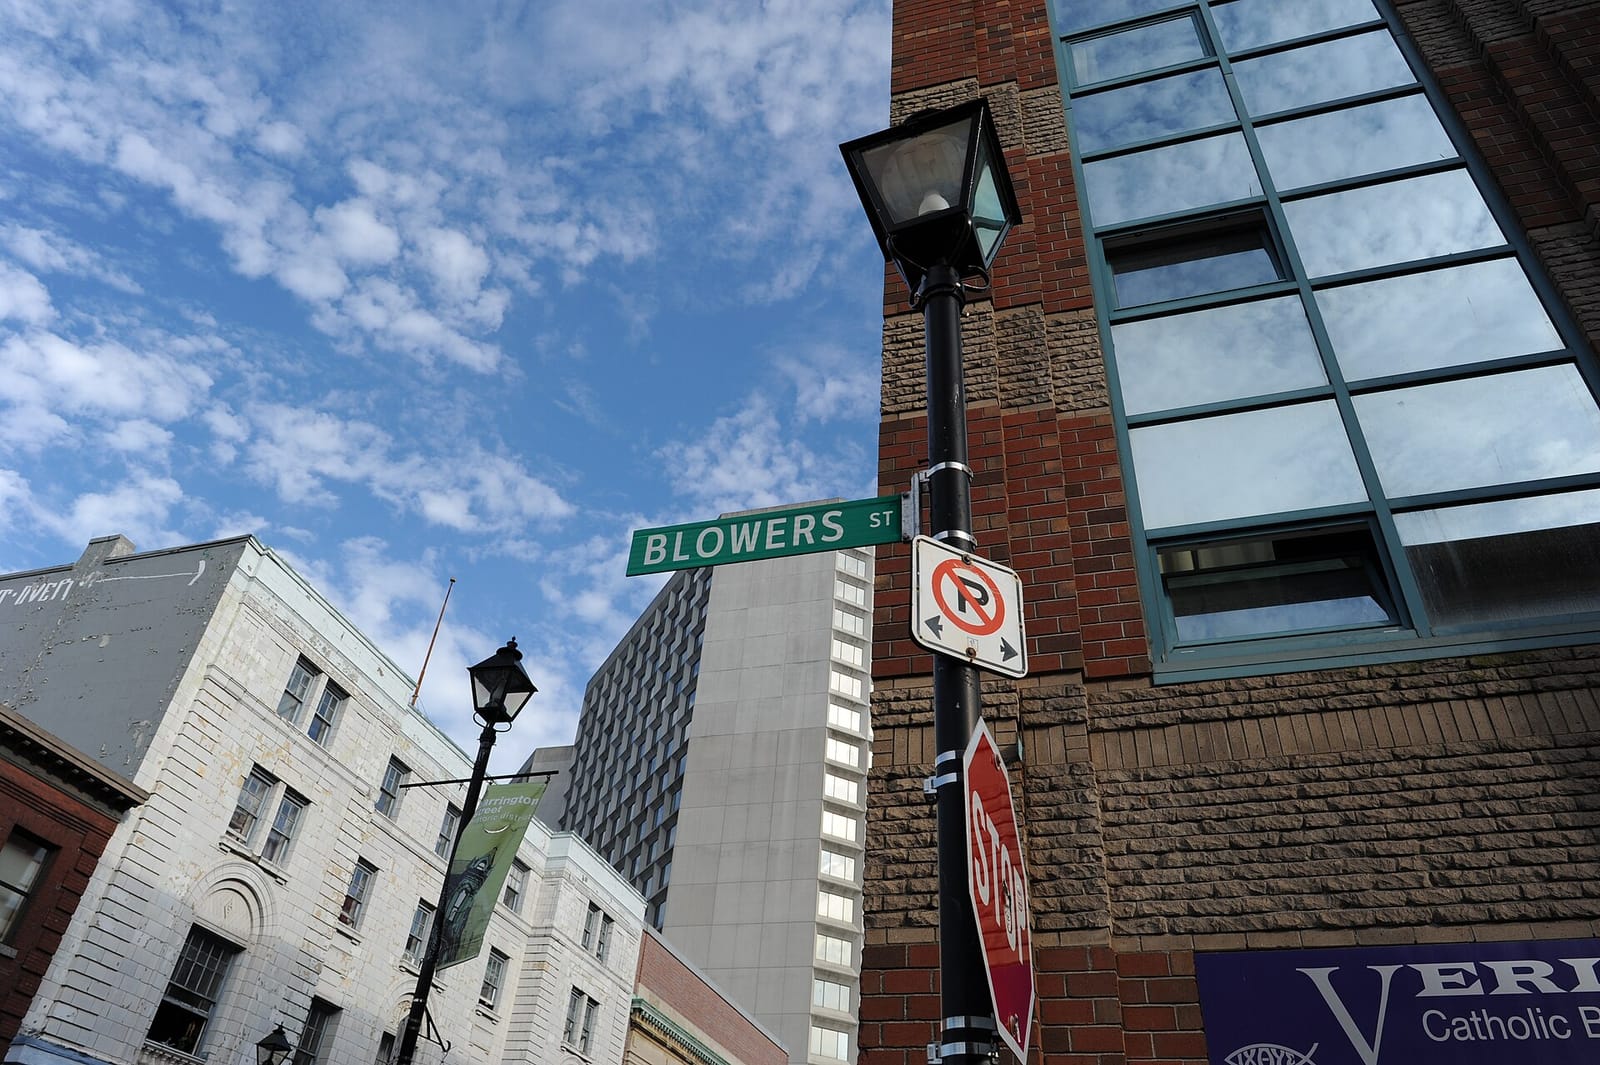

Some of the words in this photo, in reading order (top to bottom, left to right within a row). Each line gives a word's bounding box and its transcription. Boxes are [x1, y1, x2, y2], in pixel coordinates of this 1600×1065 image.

[643, 510, 845, 566] BLOWERS
[869, 510, 894, 528] ST
[480, 796, 538, 806] arrington
[972, 790, 1026, 966] STOP
[1296, 957, 1600, 1065] VERI
[1422, 1006, 1572, 1042] Catholic
